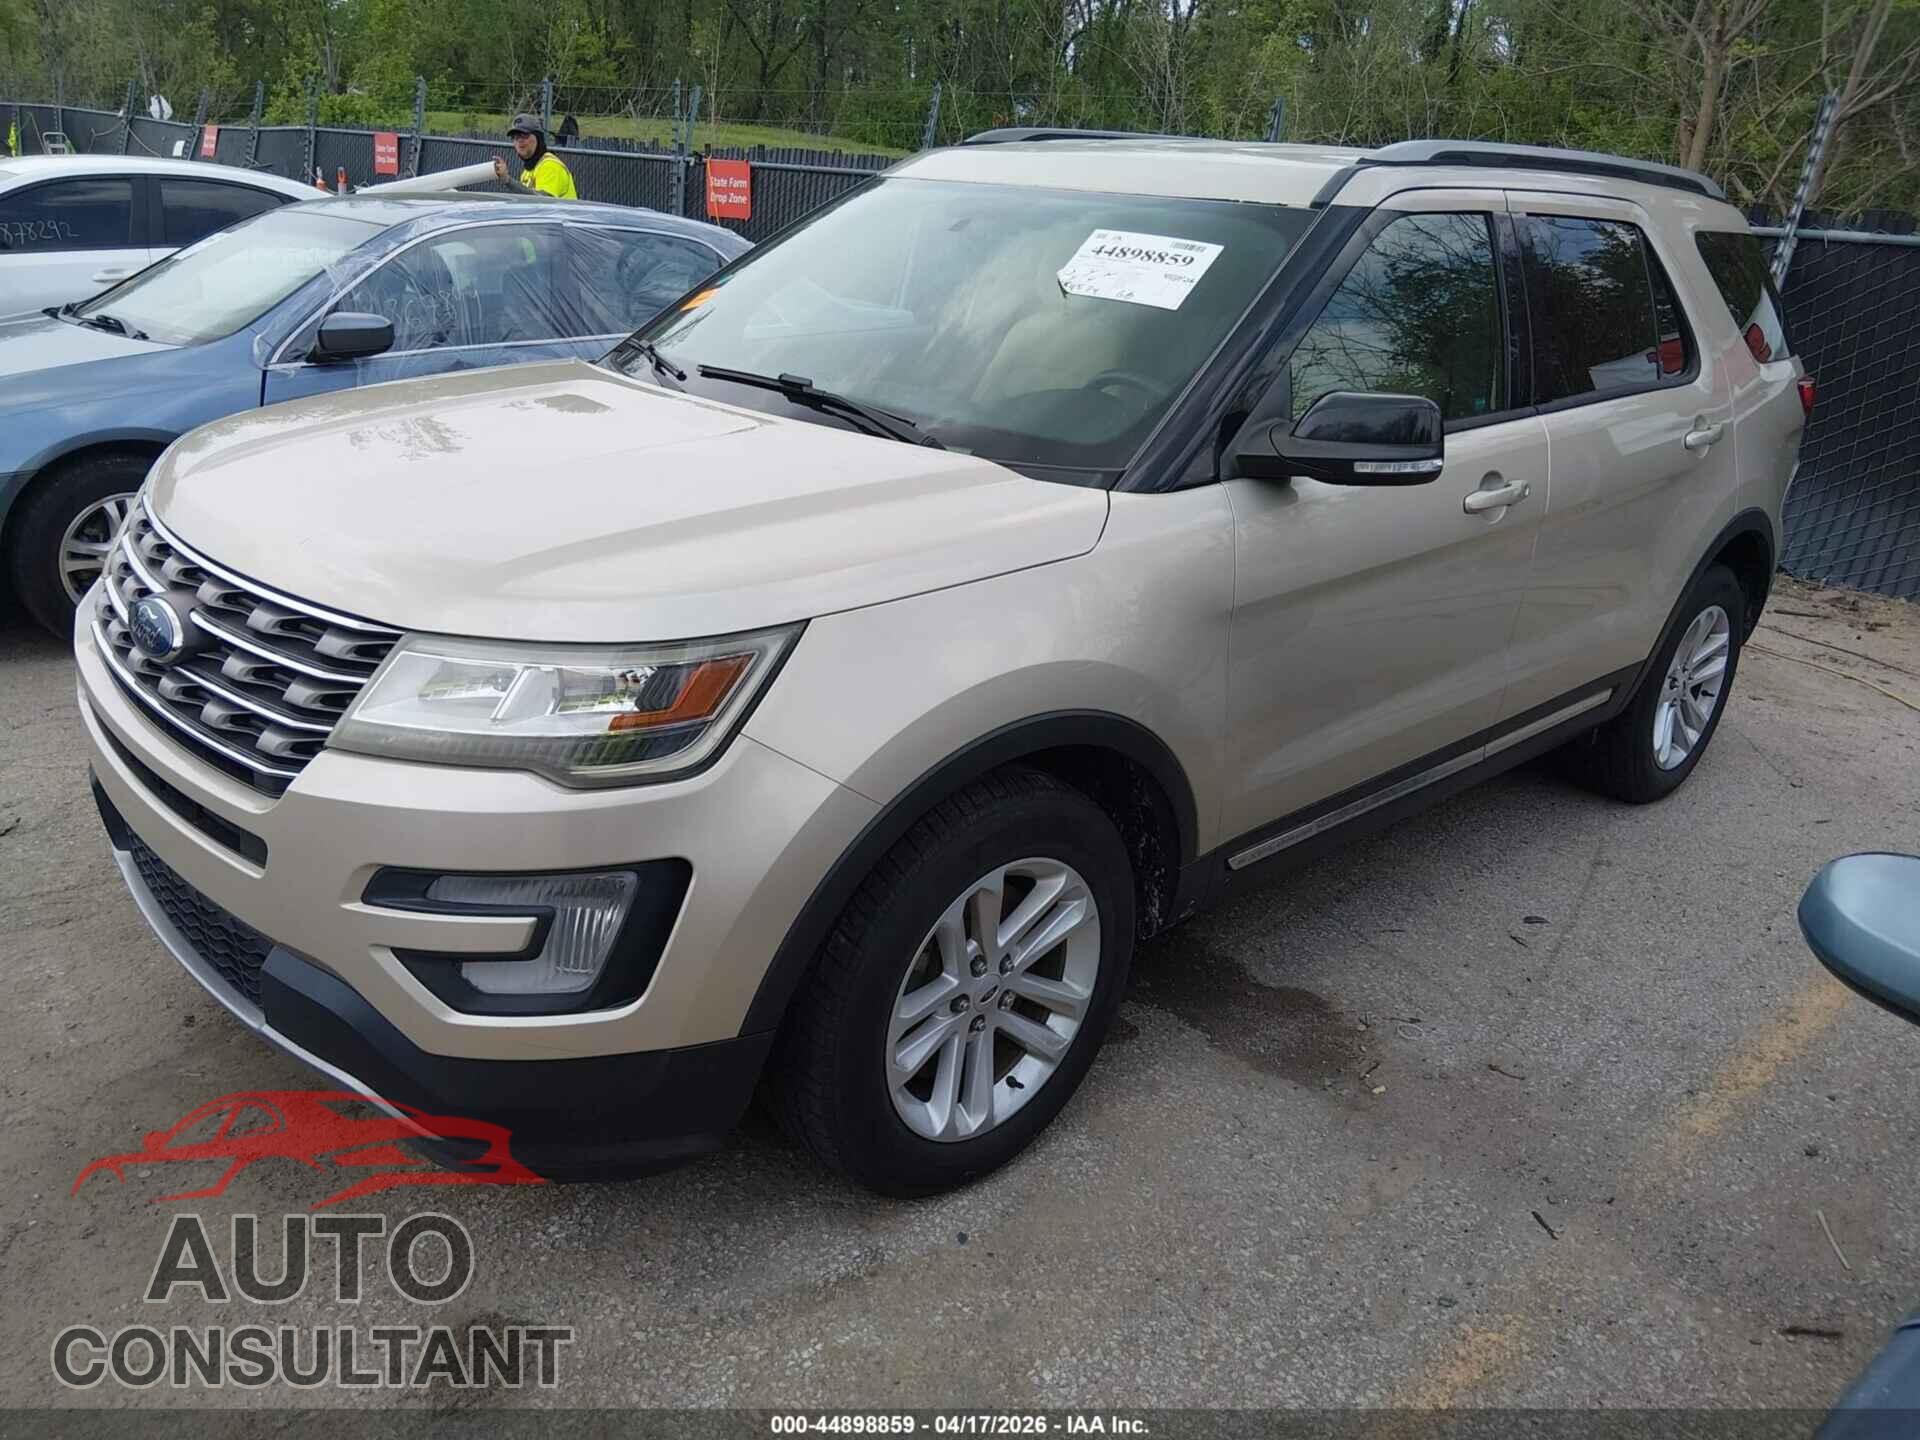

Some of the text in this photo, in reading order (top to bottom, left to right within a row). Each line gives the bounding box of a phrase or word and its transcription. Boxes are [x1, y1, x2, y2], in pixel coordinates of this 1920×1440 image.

[729, 176, 747, 188] Farm
[729, 192, 748, 204] Zone
[1091, 243, 1195, 268] 44898859
